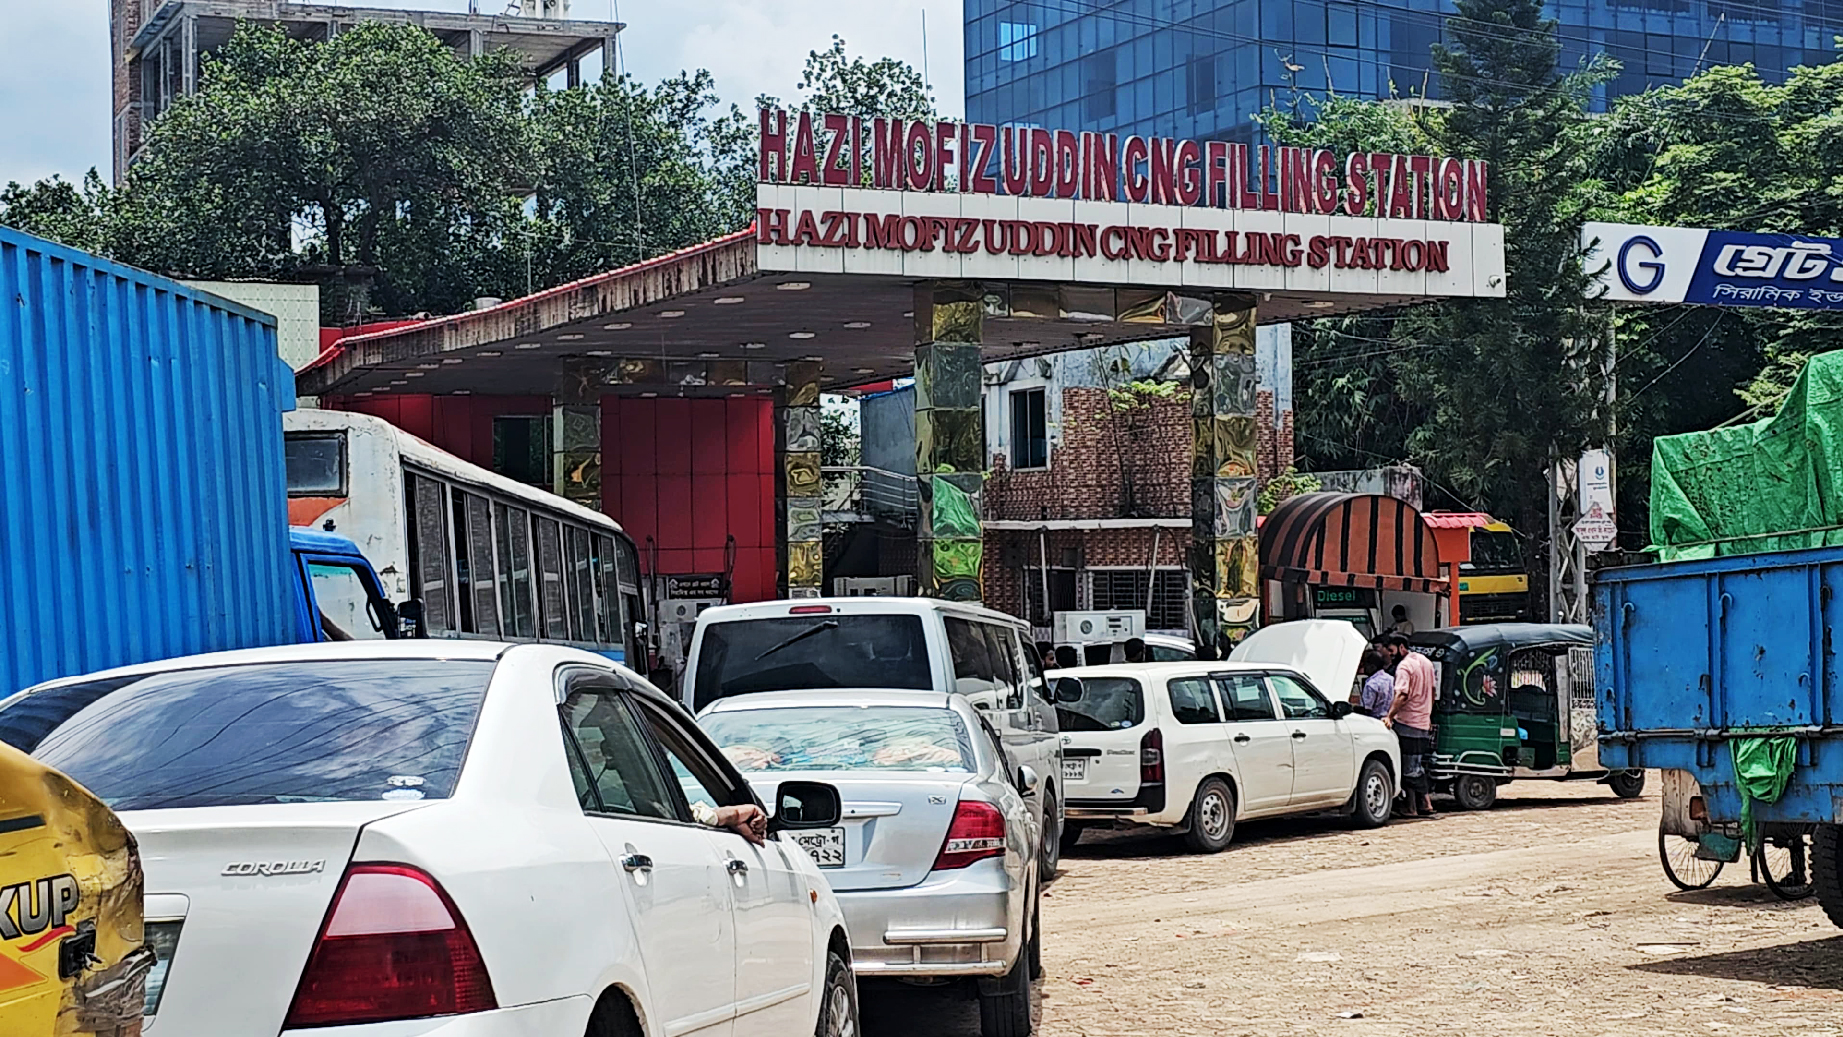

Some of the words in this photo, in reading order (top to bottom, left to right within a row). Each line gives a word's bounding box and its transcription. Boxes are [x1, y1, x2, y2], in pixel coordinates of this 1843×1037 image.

[760, 108, 861, 186] HAZI
[874, 117, 997, 193] MOFIZ
[1002, 126, 1118, 201] UDDIN
[1122, 135, 1200, 206] CNG
[1204, 140, 1339, 215] FILLING
[1345, 151, 1487, 222] STATION
[758, 208, 862, 248] HAZI
[864, 213, 981, 254] MOFIZ
[983, 219, 1099, 258] UDDIN
[1101, 226, 1173, 262] CNG
[1173, 228, 1304, 268] FILLING
[1307, 235, 1449, 272] STATION
[1617, 235, 1665, 295] G
[1711, 283, 1804, 301] সিরামিক
[1317, 590, 1356, 602] Diesel
[220, 859, 325, 877] COROLLA
